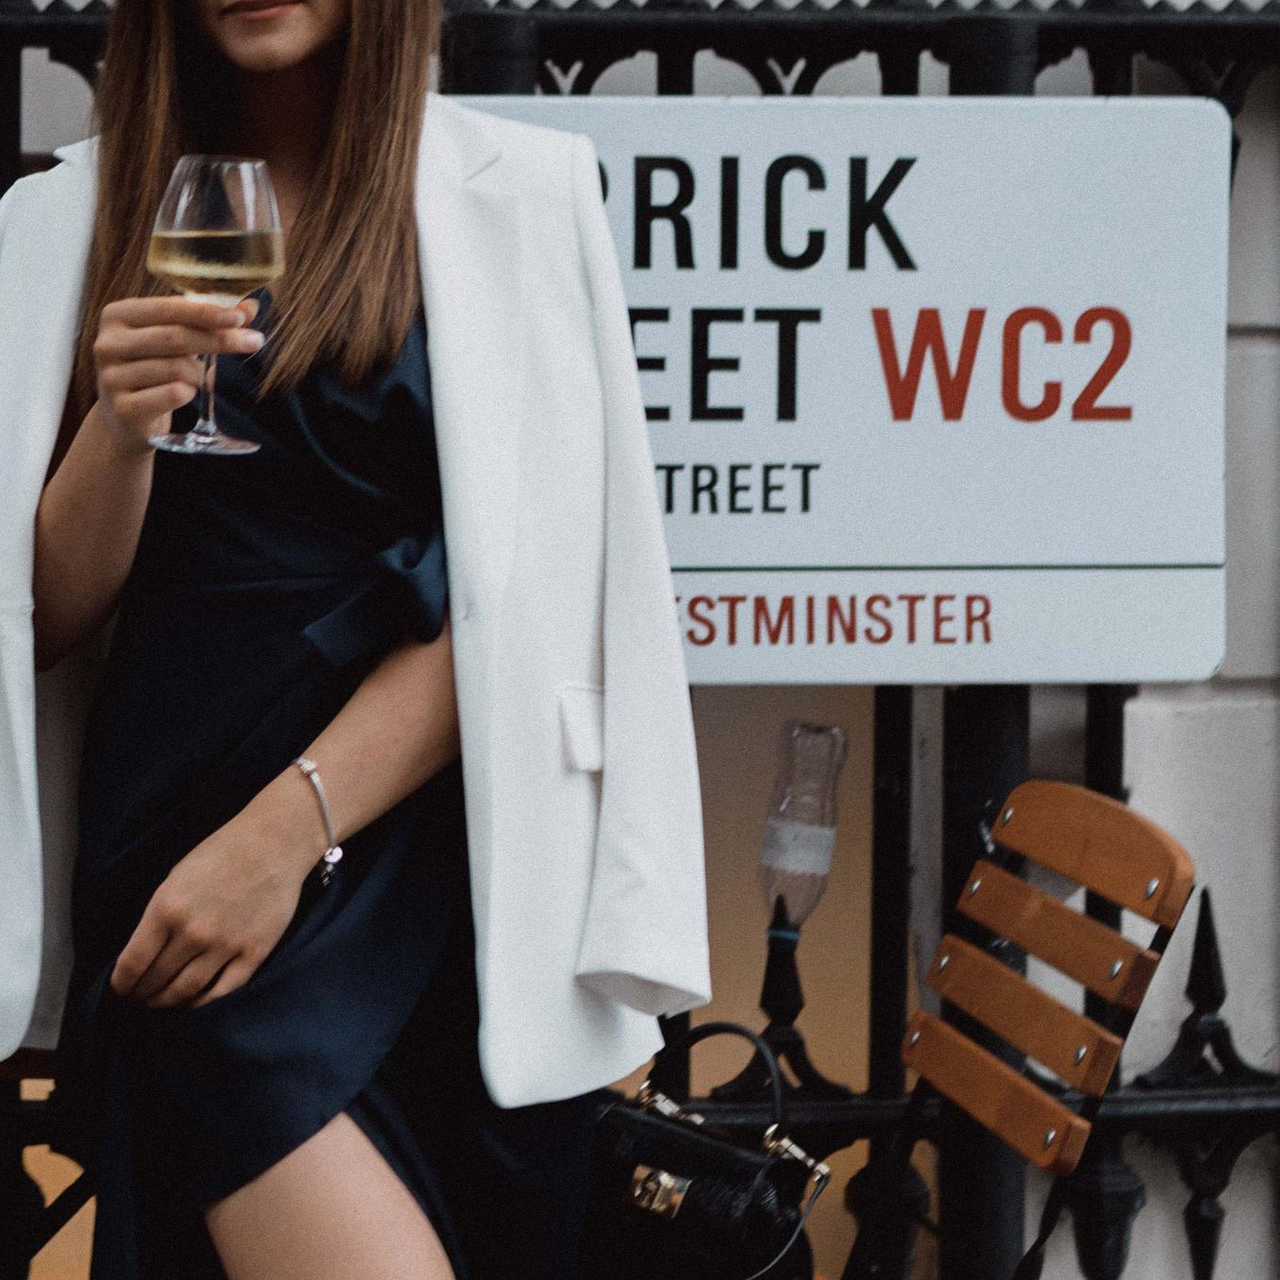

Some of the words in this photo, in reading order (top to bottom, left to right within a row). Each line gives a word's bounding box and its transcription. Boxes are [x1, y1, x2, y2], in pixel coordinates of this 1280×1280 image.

[598, 154, 920, 272] RICK
[871, 306, 1133, 423] WC2
[656, 464, 822, 515] TREET
[674, 594, 993, 646] STMINSTER
